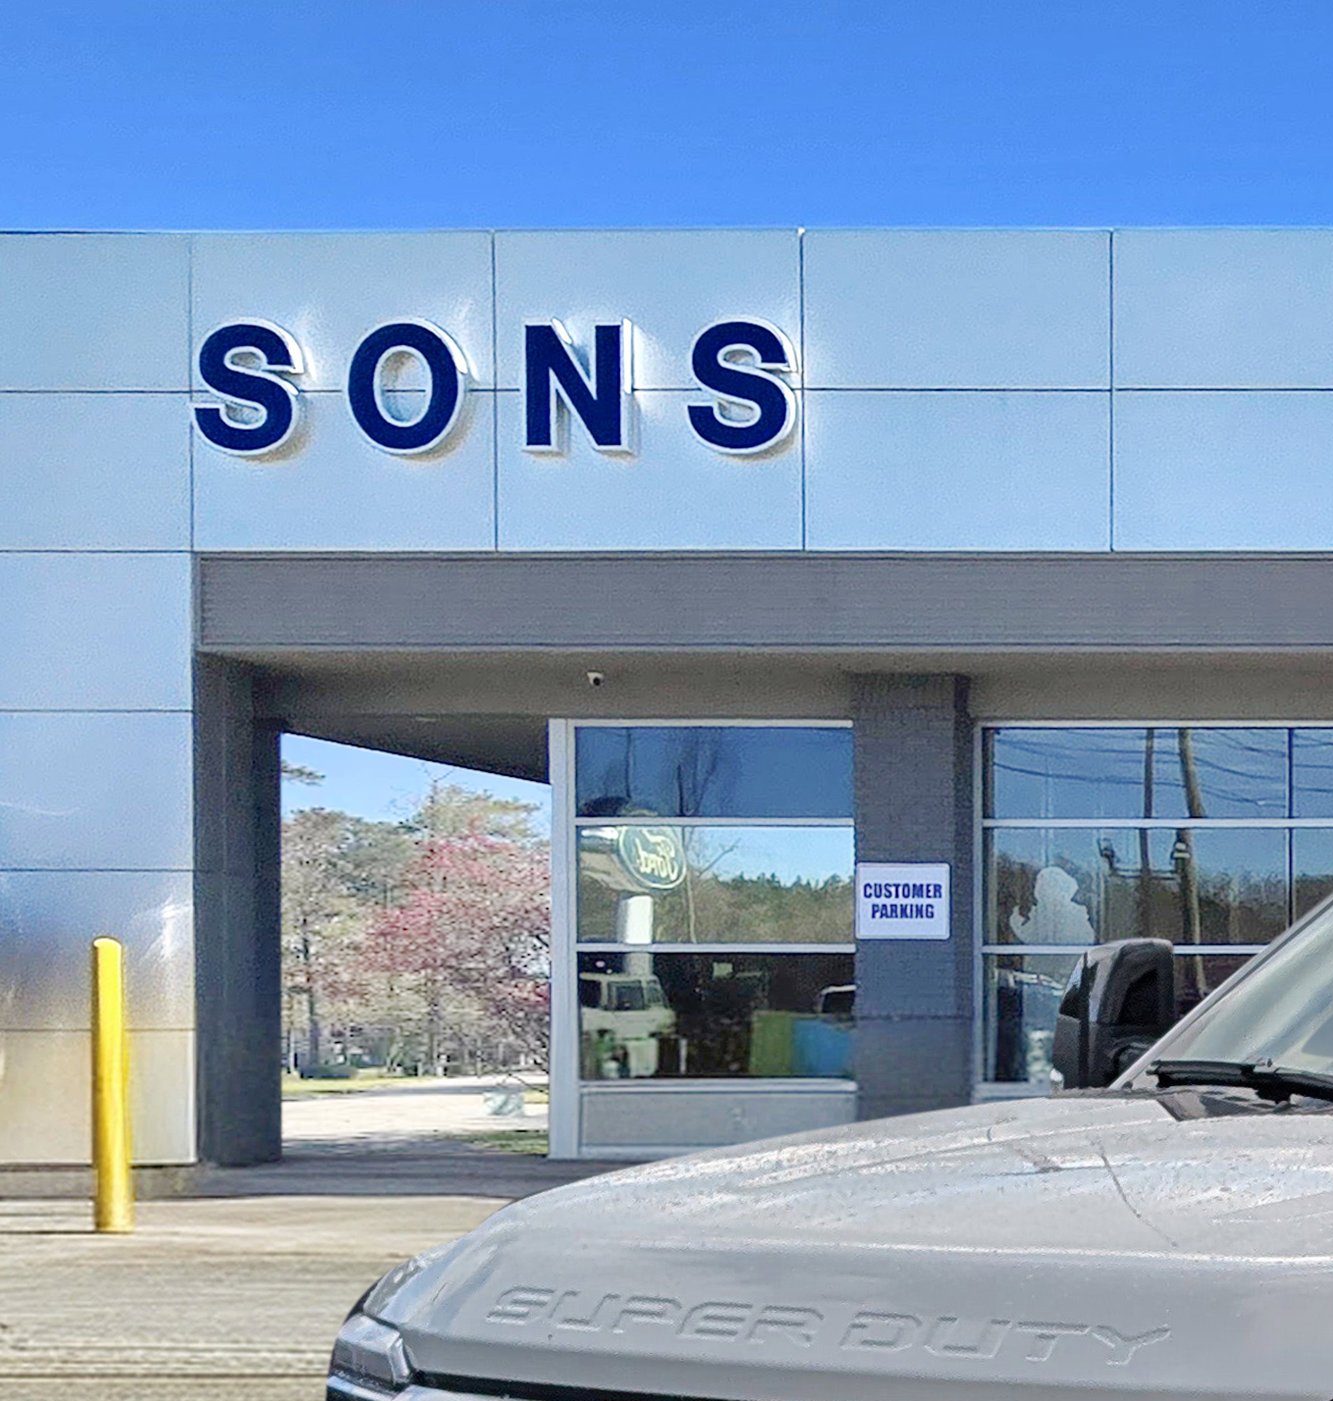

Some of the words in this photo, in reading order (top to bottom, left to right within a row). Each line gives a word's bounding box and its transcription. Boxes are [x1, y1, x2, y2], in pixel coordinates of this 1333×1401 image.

[193, 318, 798, 454] SONS
[863, 882, 943, 899] CUSTOMER
[871, 903, 935, 919] PARKING
[486, 1285, 824, 1349] SUPER
[839, 1310, 1172, 1366] DUTY
